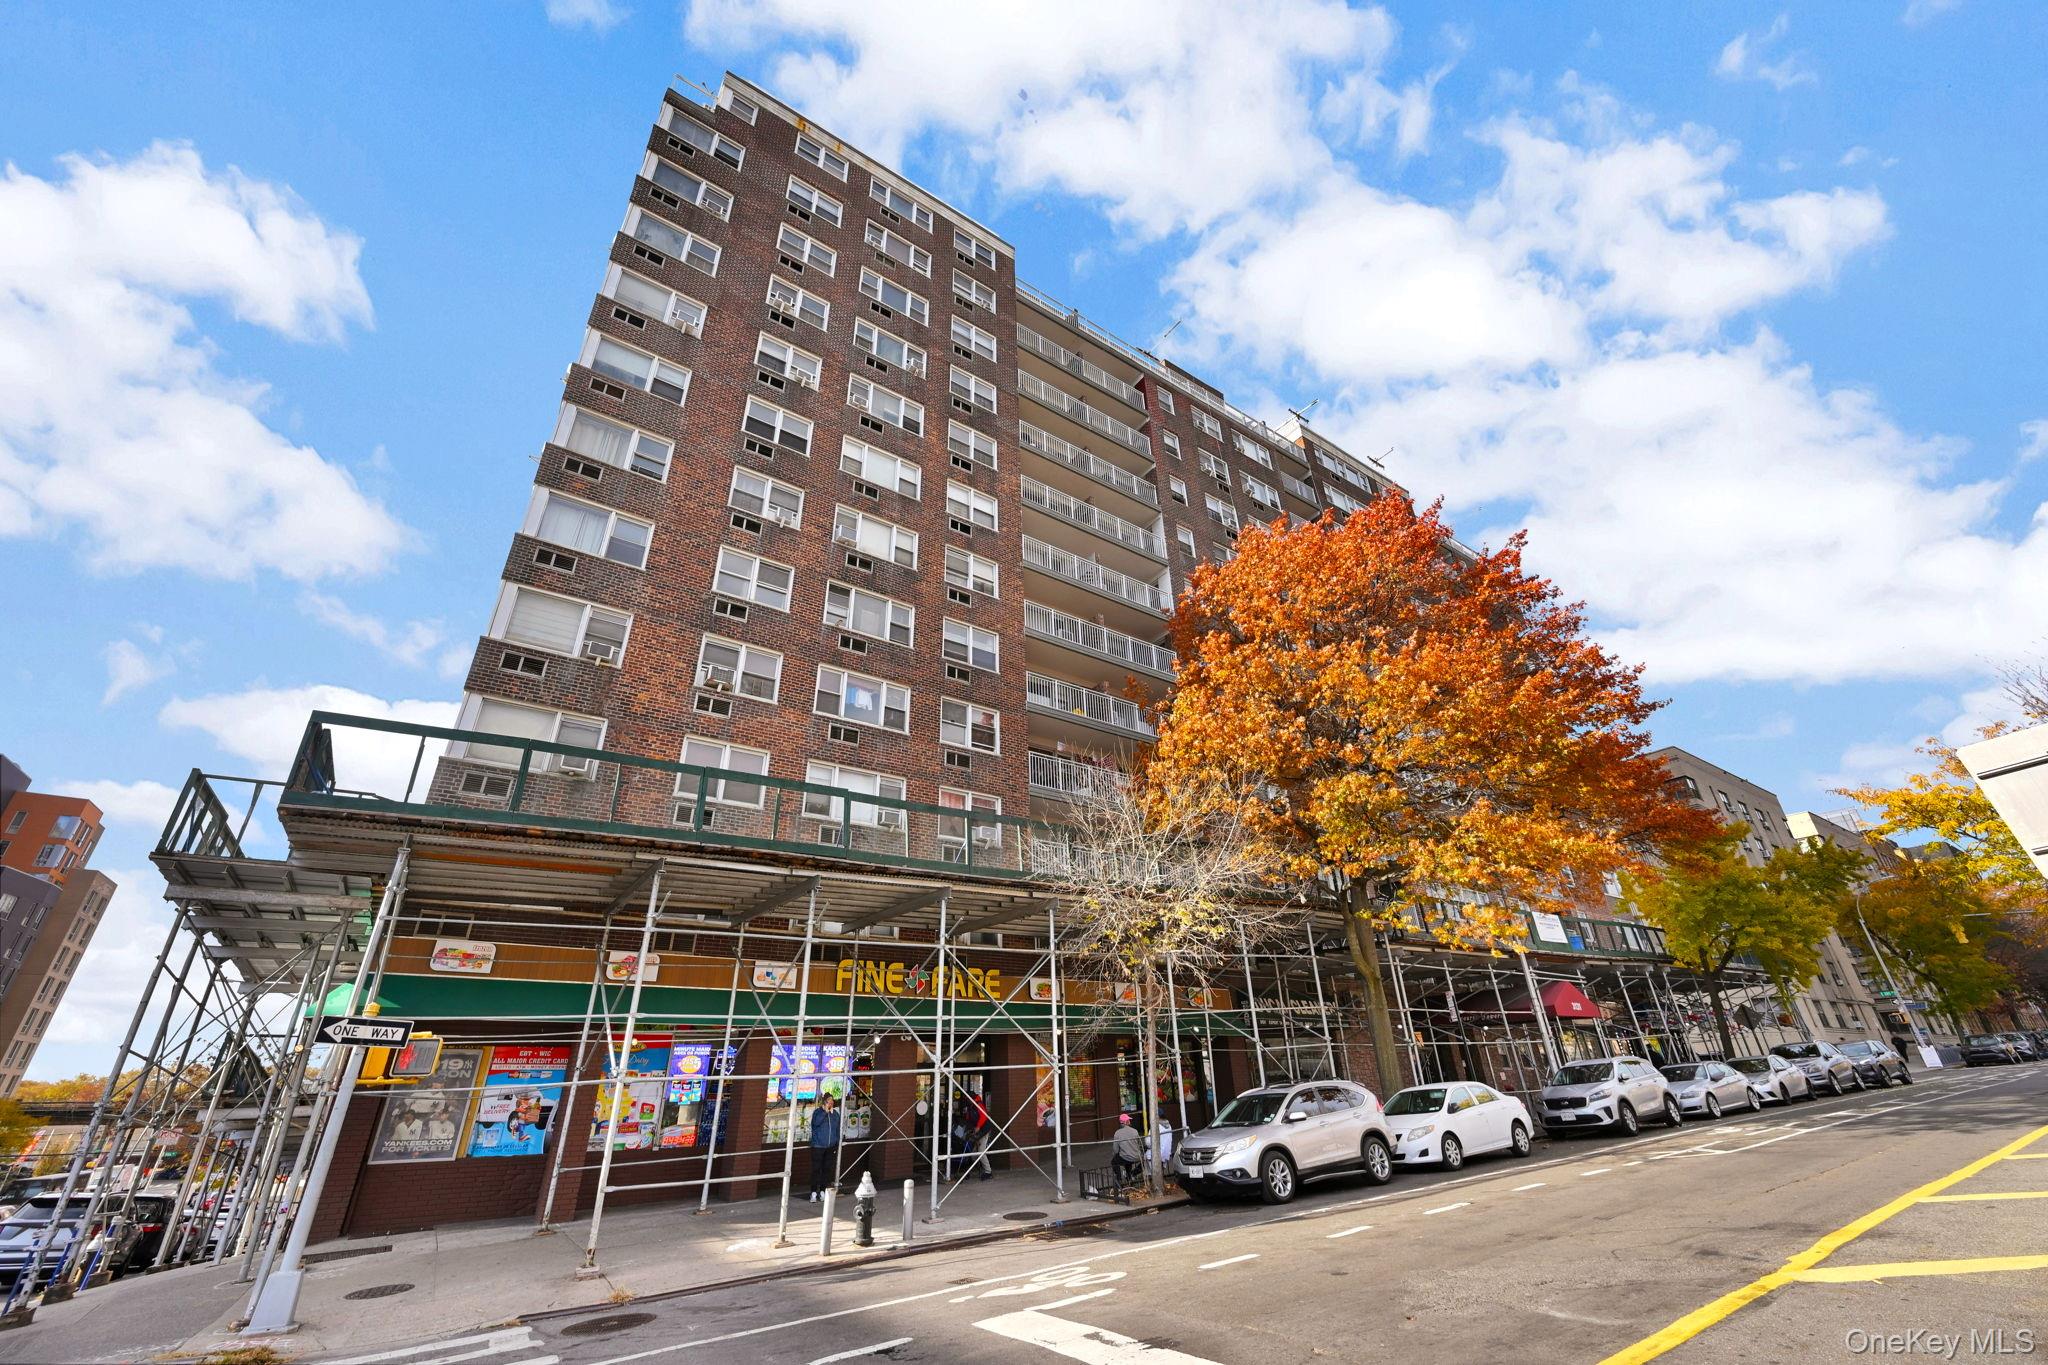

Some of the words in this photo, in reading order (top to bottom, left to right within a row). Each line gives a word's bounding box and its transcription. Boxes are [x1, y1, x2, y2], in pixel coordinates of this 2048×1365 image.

[836, 959, 904, 994] FINE
[931, 965, 1001, 999] FARE
[332, 1025, 360, 1037] ONE
[370, 1028, 399, 1039] WAY
[384, 1139, 453, 1147] YANKEES.COM
